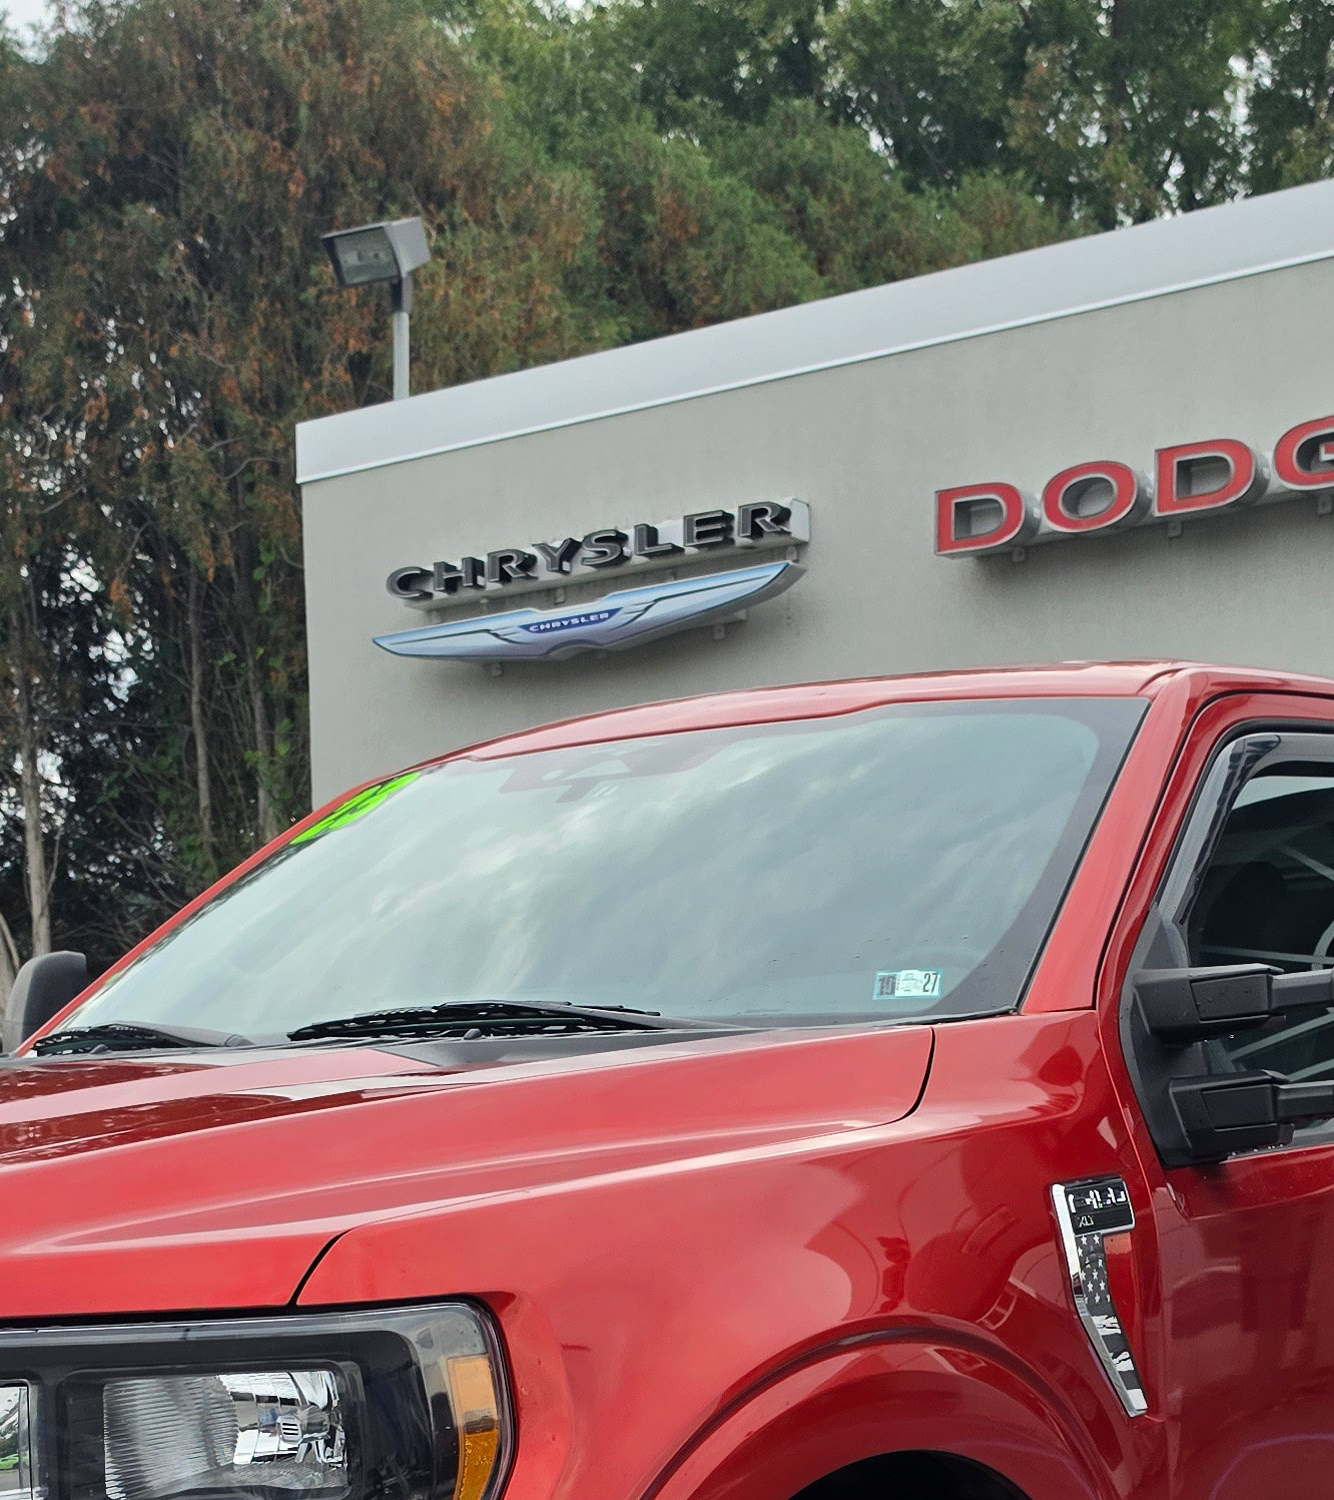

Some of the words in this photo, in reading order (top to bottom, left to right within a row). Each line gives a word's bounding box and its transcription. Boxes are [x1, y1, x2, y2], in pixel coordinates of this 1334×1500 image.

[385, 500, 793, 600] CHRYSLER
[528, 612, 610, 633] CHRYSLER
[922, 972, 939, 994] 27
